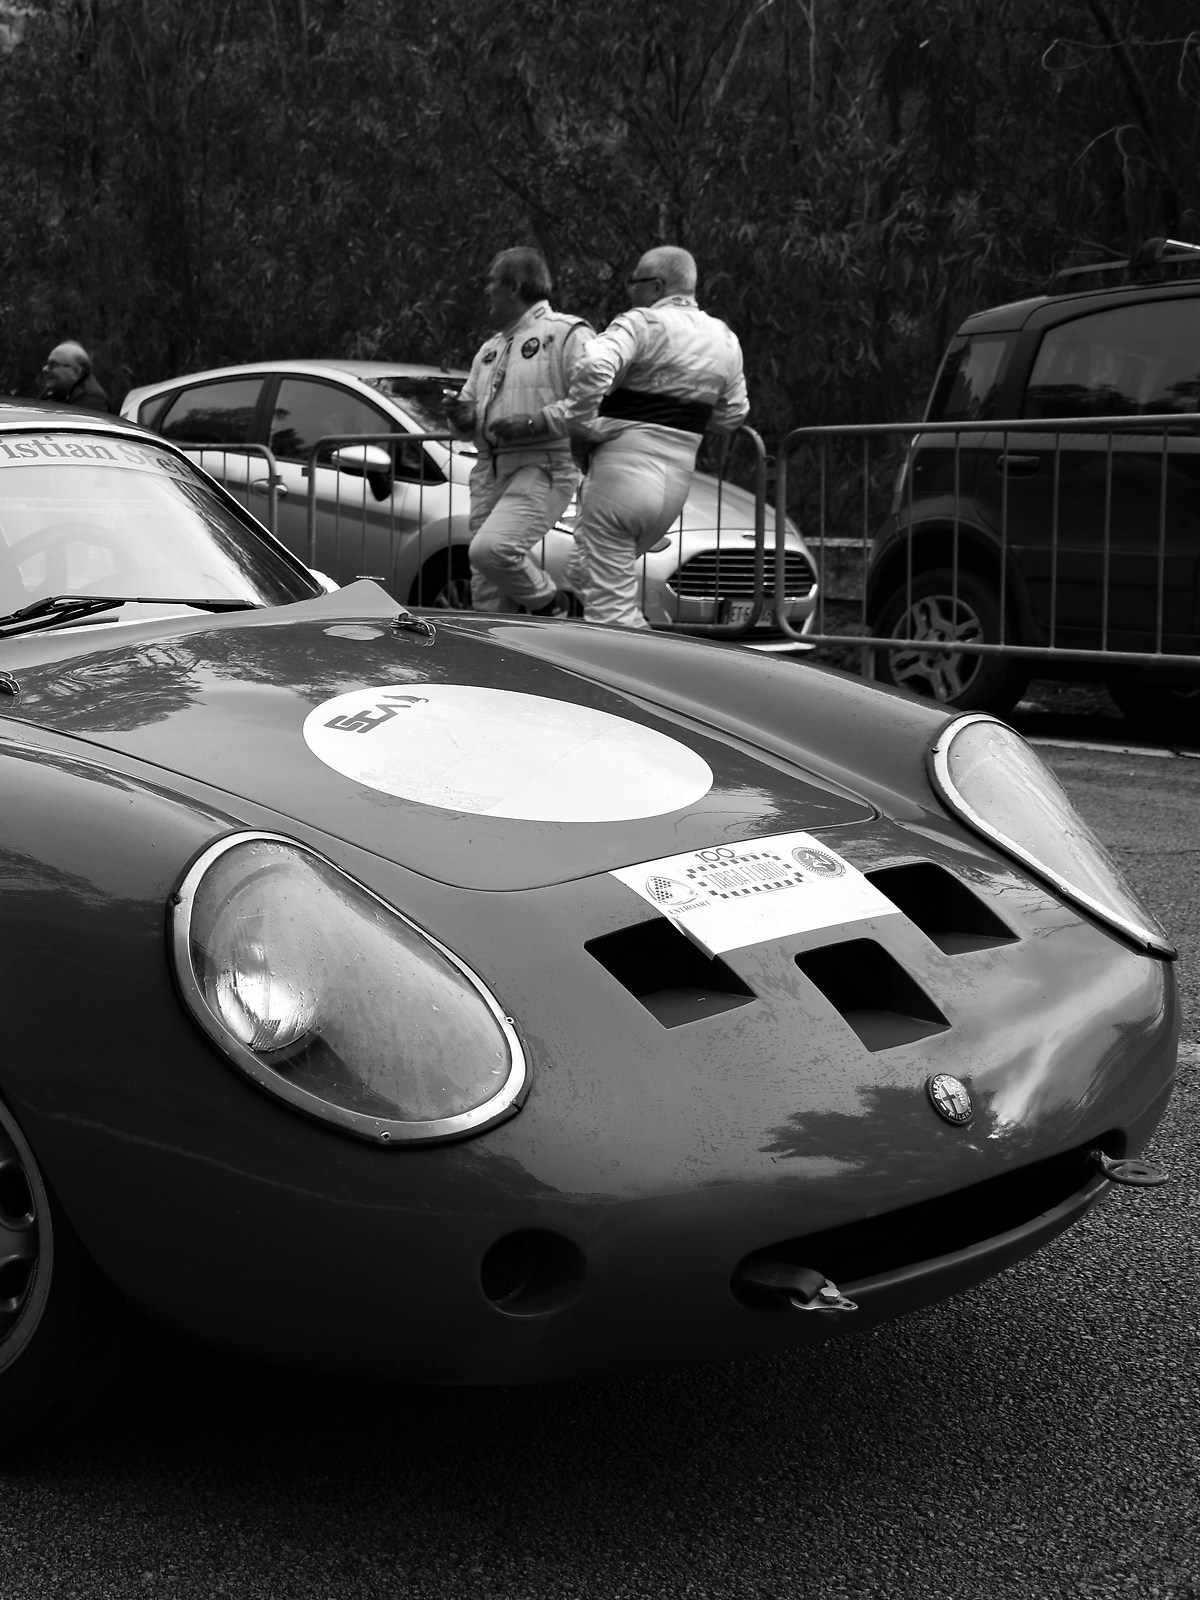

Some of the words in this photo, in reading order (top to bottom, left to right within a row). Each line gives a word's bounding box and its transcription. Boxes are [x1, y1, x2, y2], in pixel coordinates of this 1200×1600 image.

[694, 847, 735, 864] 100
[702, 869, 752, 890] TARGA
[738, 861, 788, 882] FLORIO
